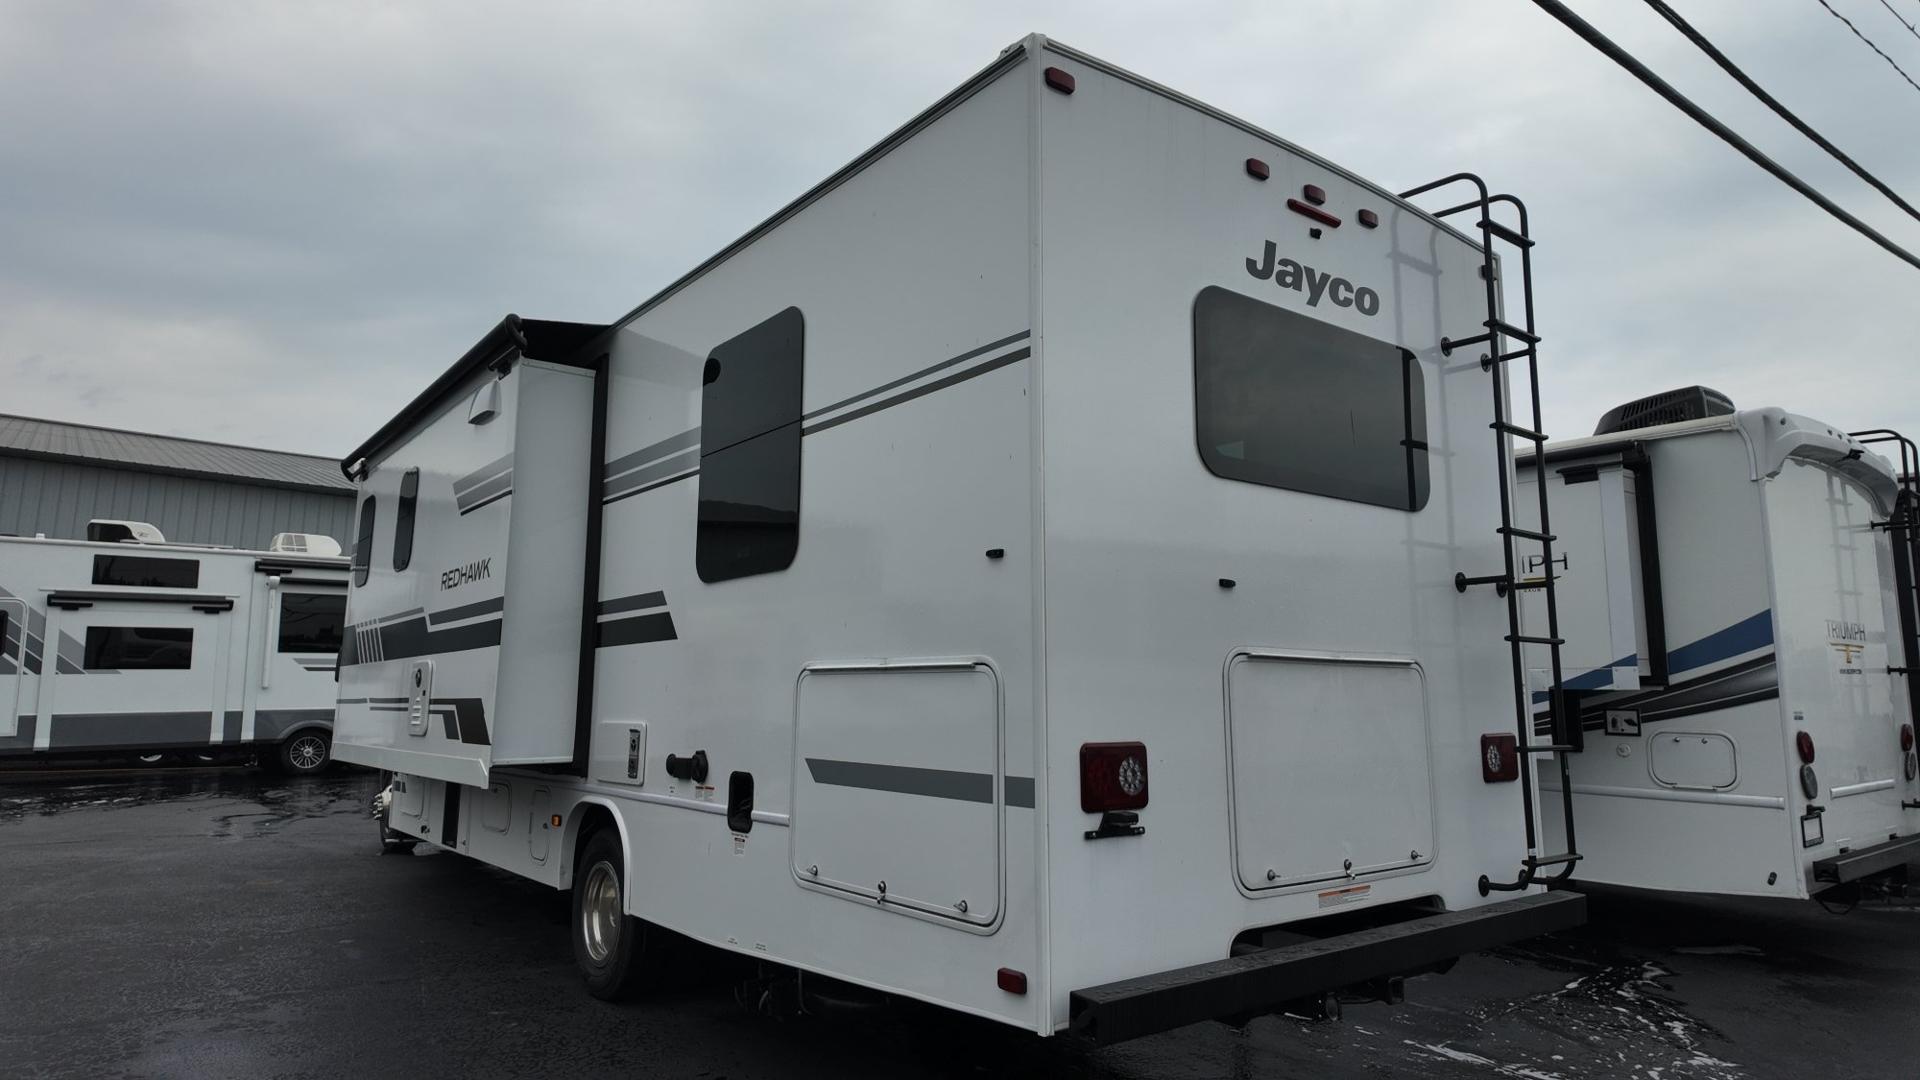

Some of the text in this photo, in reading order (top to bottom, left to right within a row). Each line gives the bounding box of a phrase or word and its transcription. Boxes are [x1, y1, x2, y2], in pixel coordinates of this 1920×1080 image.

[1245, 239, 1380, 317] Jayco
[440, 557, 492, 591] REDHAWK
[1825, 619, 1866, 641] TRIUMPH
